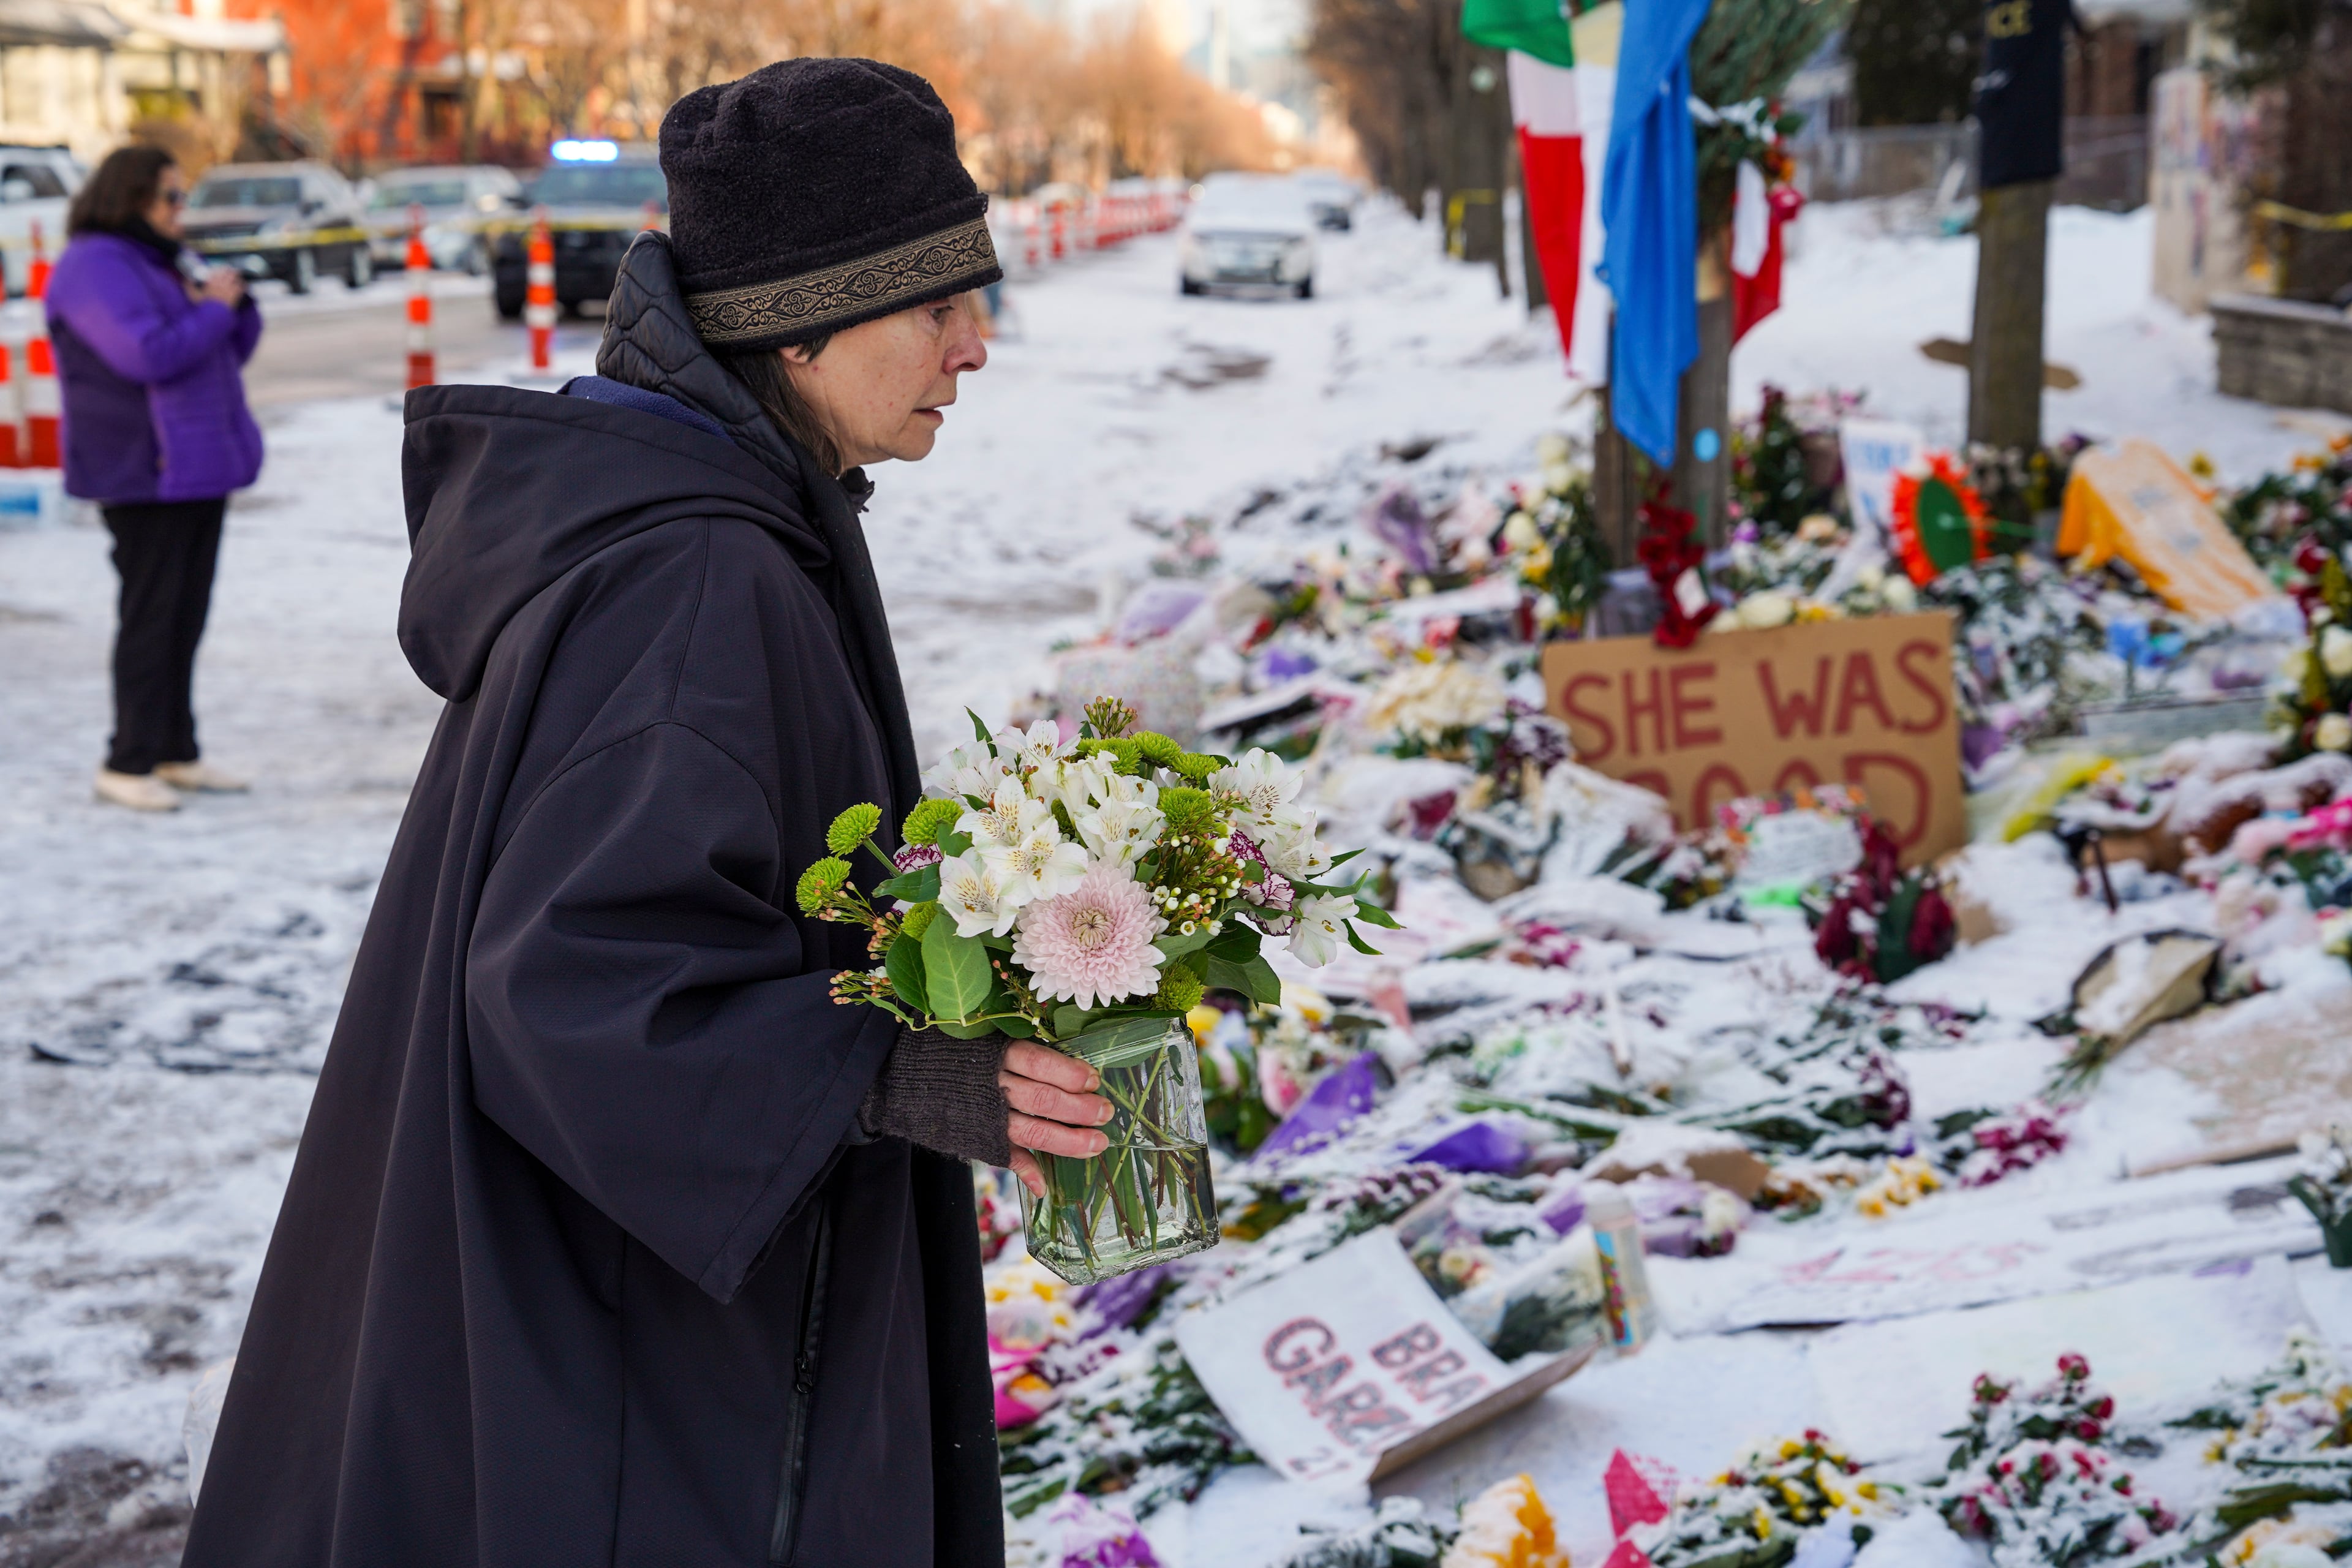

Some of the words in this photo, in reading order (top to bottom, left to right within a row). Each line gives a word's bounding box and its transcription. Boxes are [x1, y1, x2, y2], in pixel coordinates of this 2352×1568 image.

[1561, 662, 1723, 764] SHE
[1758, 639, 1949, 742] WAS
[1370, 1321, 1488, 1415] BRA
